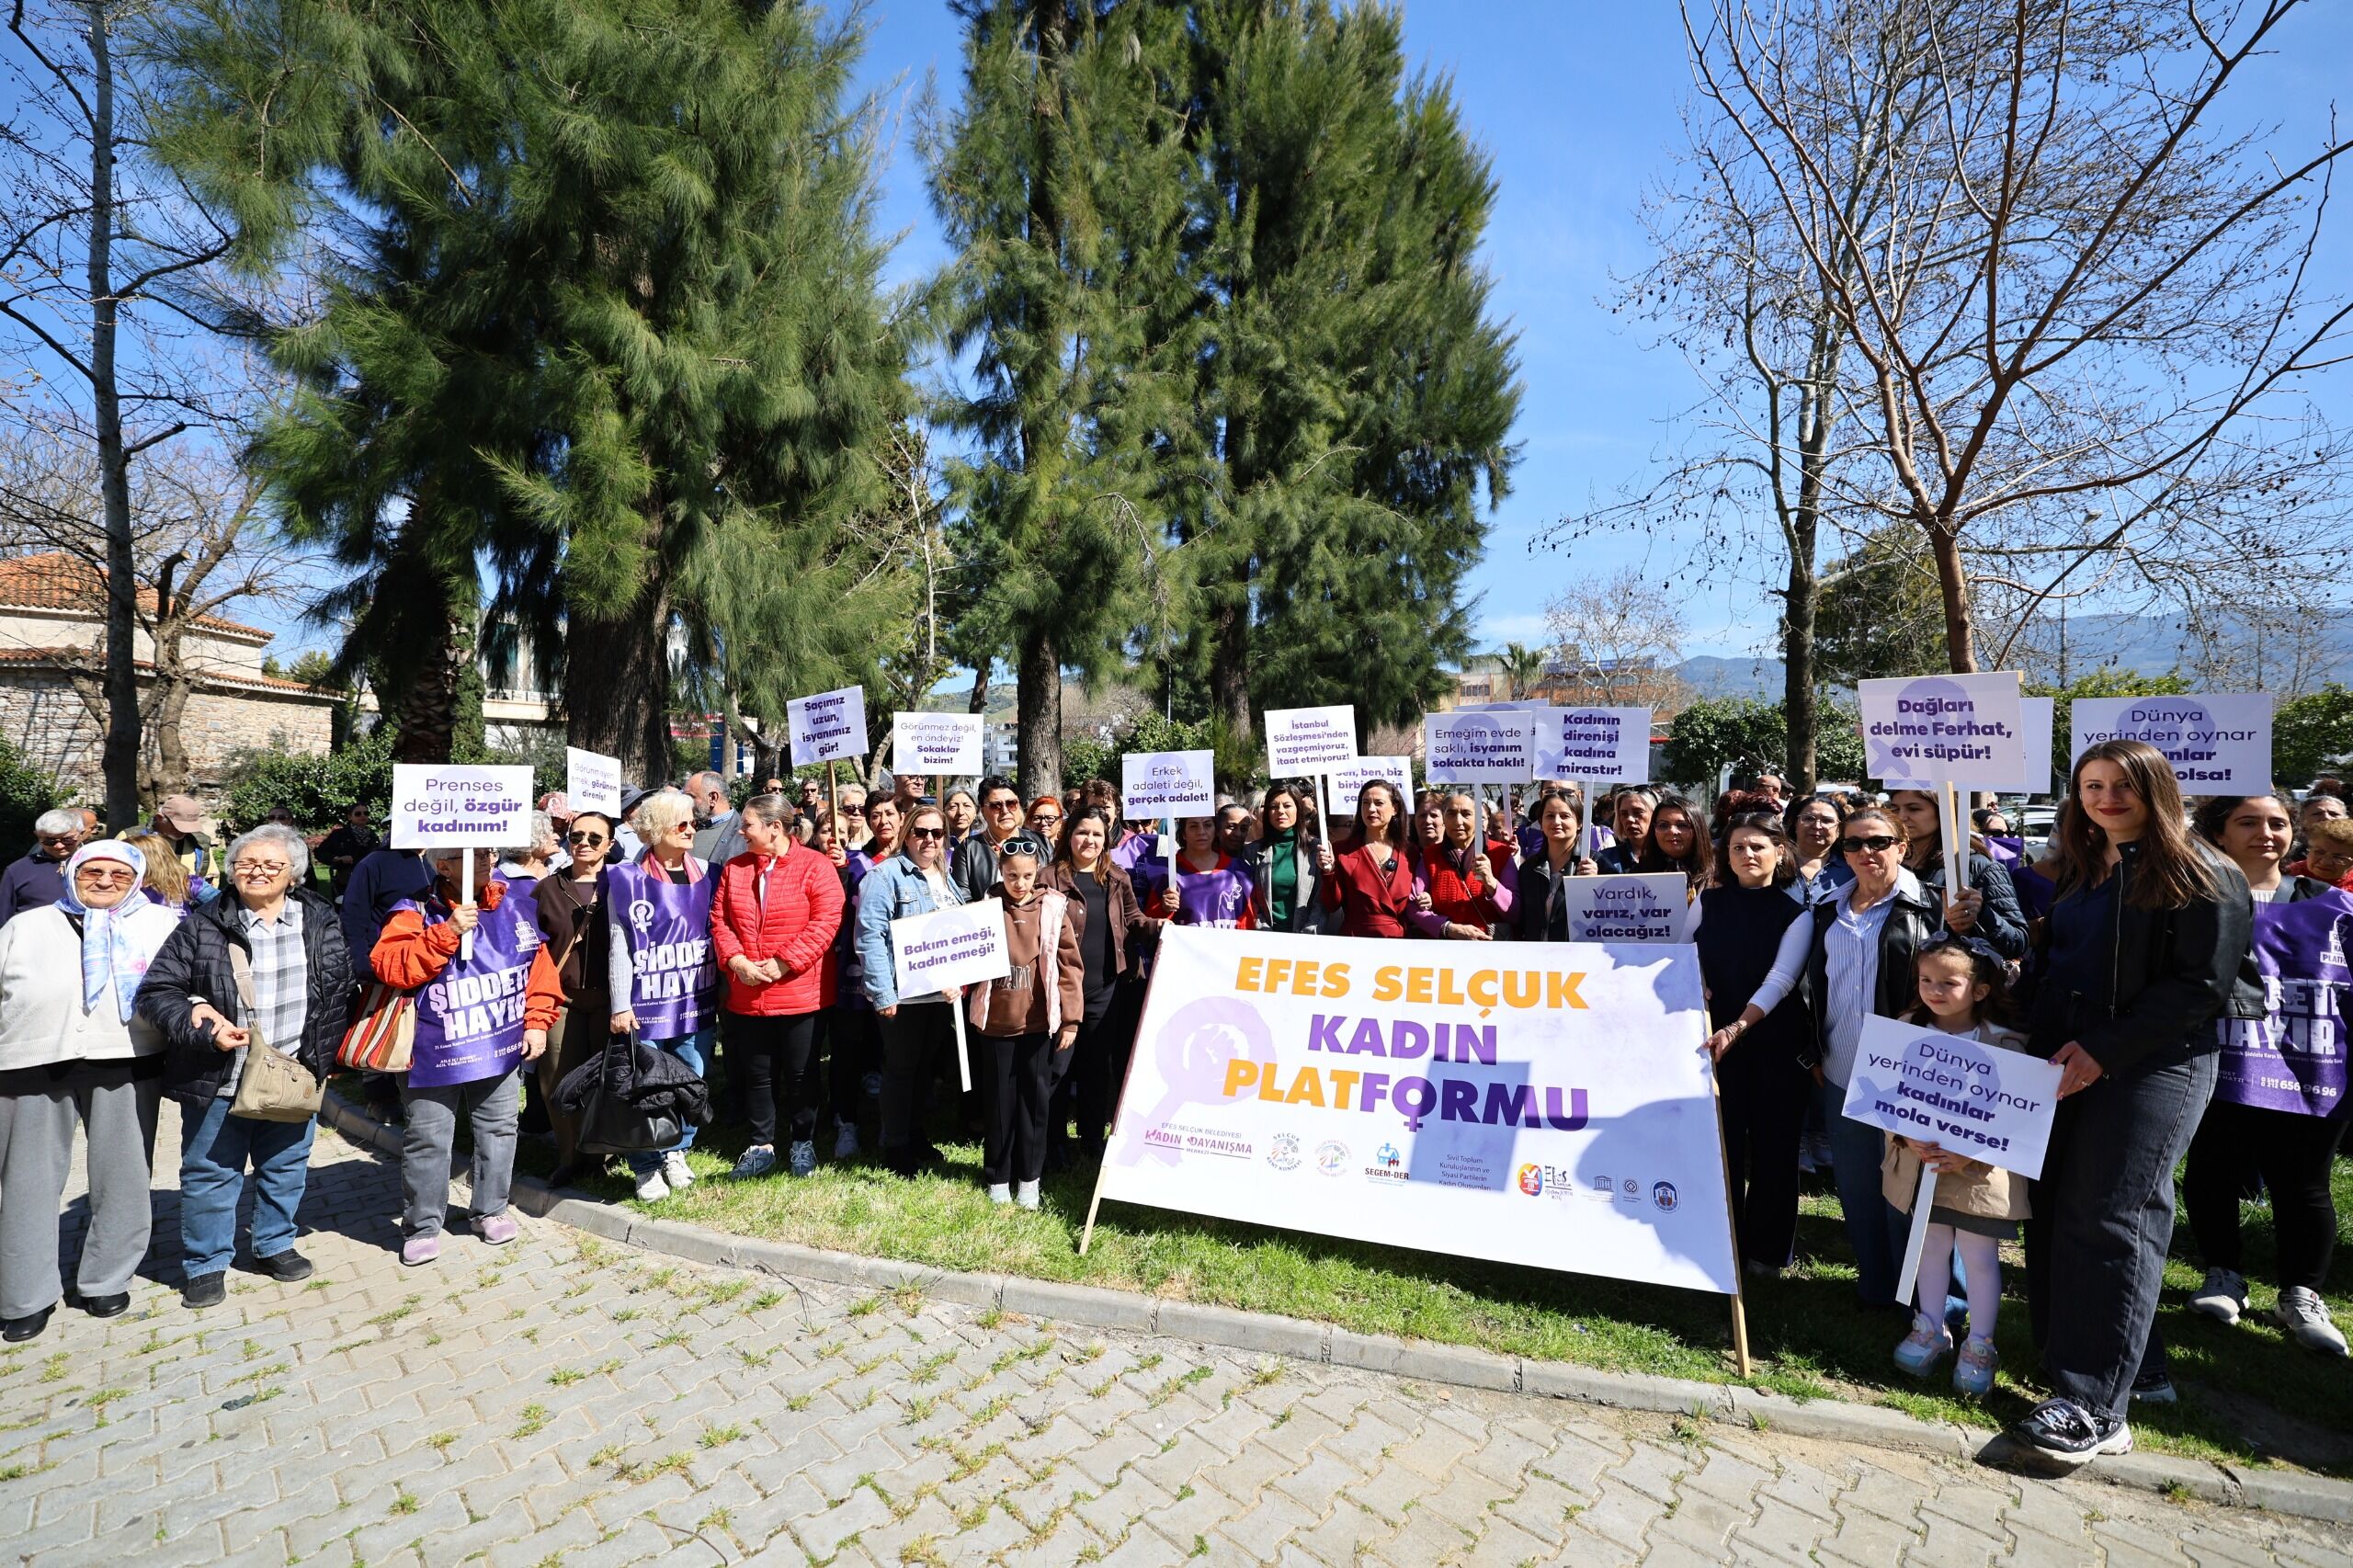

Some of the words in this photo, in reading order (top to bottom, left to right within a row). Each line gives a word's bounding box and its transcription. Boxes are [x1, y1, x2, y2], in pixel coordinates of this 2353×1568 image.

[804, 696, 845, 711] Saçımız
[1898, 698, 1974, 716] Dağları
[813, 714, 839, 725] uzun,
[1563, 713, 1620, 725] Kadının
[2131, 710, 2203, 724] Dünya
[900, 722, 949, 732] Görünmez
[951, 722, 977, 733] değil,
[1291, 720, 1329, 730] İstanbul
[1870, 722, 1928, 736] delme
[1932, 721, 2013, 738] Ferhat,
[802, 726, 850, 743] isyanımız
[925, 734, 963, 744] öndeyiz!
[1274, 731, 1348, 743] Sözleşmesi'nden
[1435, 728, 1486, 740] Emeğim
[1490, 728, 1521, 738] evde
[1563, 730, 1620, 743] direnişi
[2084, 730, 2180, 744] yerinden
[2187, 729, 2256, 744] oynar
[819, 743, 838, 756] gür!
[917, 745, 960, 754] Sokaklar
[1276, 743, 1348, 754] vazgeçmiyoruz,
[1435, 744, 1467, 755] saklı,
[1470, 743, 1522, 754] isyanım
[1564, 747, 1616, 759] kadına
[1891, 743, 1920, 757] evi
[1924, 744, 1992, 762] süpür!
[923, 756, 953, 765] bizim!
[1277, 756, 1299, 766] itaat
[1301, 753, 1349, 764] etmiyoruz!
[1432, 758, 1485, 767] sokakta
[1487, 757, 1525, 767] haklı!
[1152, 767, 1182, 777] Erkek
[1360, 768, 1385, 778] ben,
[1386, 767, 1403, 777] biz
[1556, 764, 1622, 776] mirastır!
[426, 778, 504, 792] Prenses
[1132, 780, 1171, 790] adaleti
[1173, 778, 1203, 790] değil,
[582, 790, 607, 802] direniş!
[1128, 794, 1166, 806] gerçek
[1168, 792, 1209, 802] adalet!
[404, 798, 459, 815] değil,
[464, 798, 523, 815] özgür
[417, 819, 508, 833] kadınım!
[1592, 886, 1658, 901] Vardık,
[1582, 909, 1635, 920] varız,
[1639, 907, 1672, 918] var
[1586, 925, 1671, 940] olacağız!
[904, 938, 949, 956] Bakım
[950, 926, 996, 945] emeği,
[908, 955, 948, 971] kadın
[949, 943, 995, 960] emeği!
[1235, 956, 1351, 999] EFES
[1371, 965, 1590, 1019] SELÇUK
[1308, 1014, 1497, 1066] KADIN
[1919, 1043, 1992, 1075] Dünya
[1869, 1053, 1963, 1091] yerinden
[1970, 1084, 2040, 1112] oynar
[2280, 1080, 2301, 1091] 656
[2303, 1083, 2320, 1095] 96
[2322, 1086, 2337, 1096] 96
[1222, 1058, 1589, 1132] PLATFORMU
[1897, 1081, 1995, 1122] kadınlar
[1161, 1122, 1177, 1131] EFES
[1178, 1124, 1203, 1134] SELÇUK
[1205, 1129, 1242, 1139] BELEDİYESİ
[1874, 1099, 1930, 1127] mola
[1937, 1119, 2010, 1152] verse!
[1145, 1129, 1182, 1144] KADIN
[1187, 1136, 1253, 1154] DAYANIŞMA
[1460, 1155, 1483, 1165] Toplum
[1365, 1167, 1409, 1180] SEGEM-DER
[1441, 1171, 1458, 1180] Siyasi
[1459, 1173, 1487, 1183] Partilerin
[1438, 1179, 1457, 1187] Kadın
